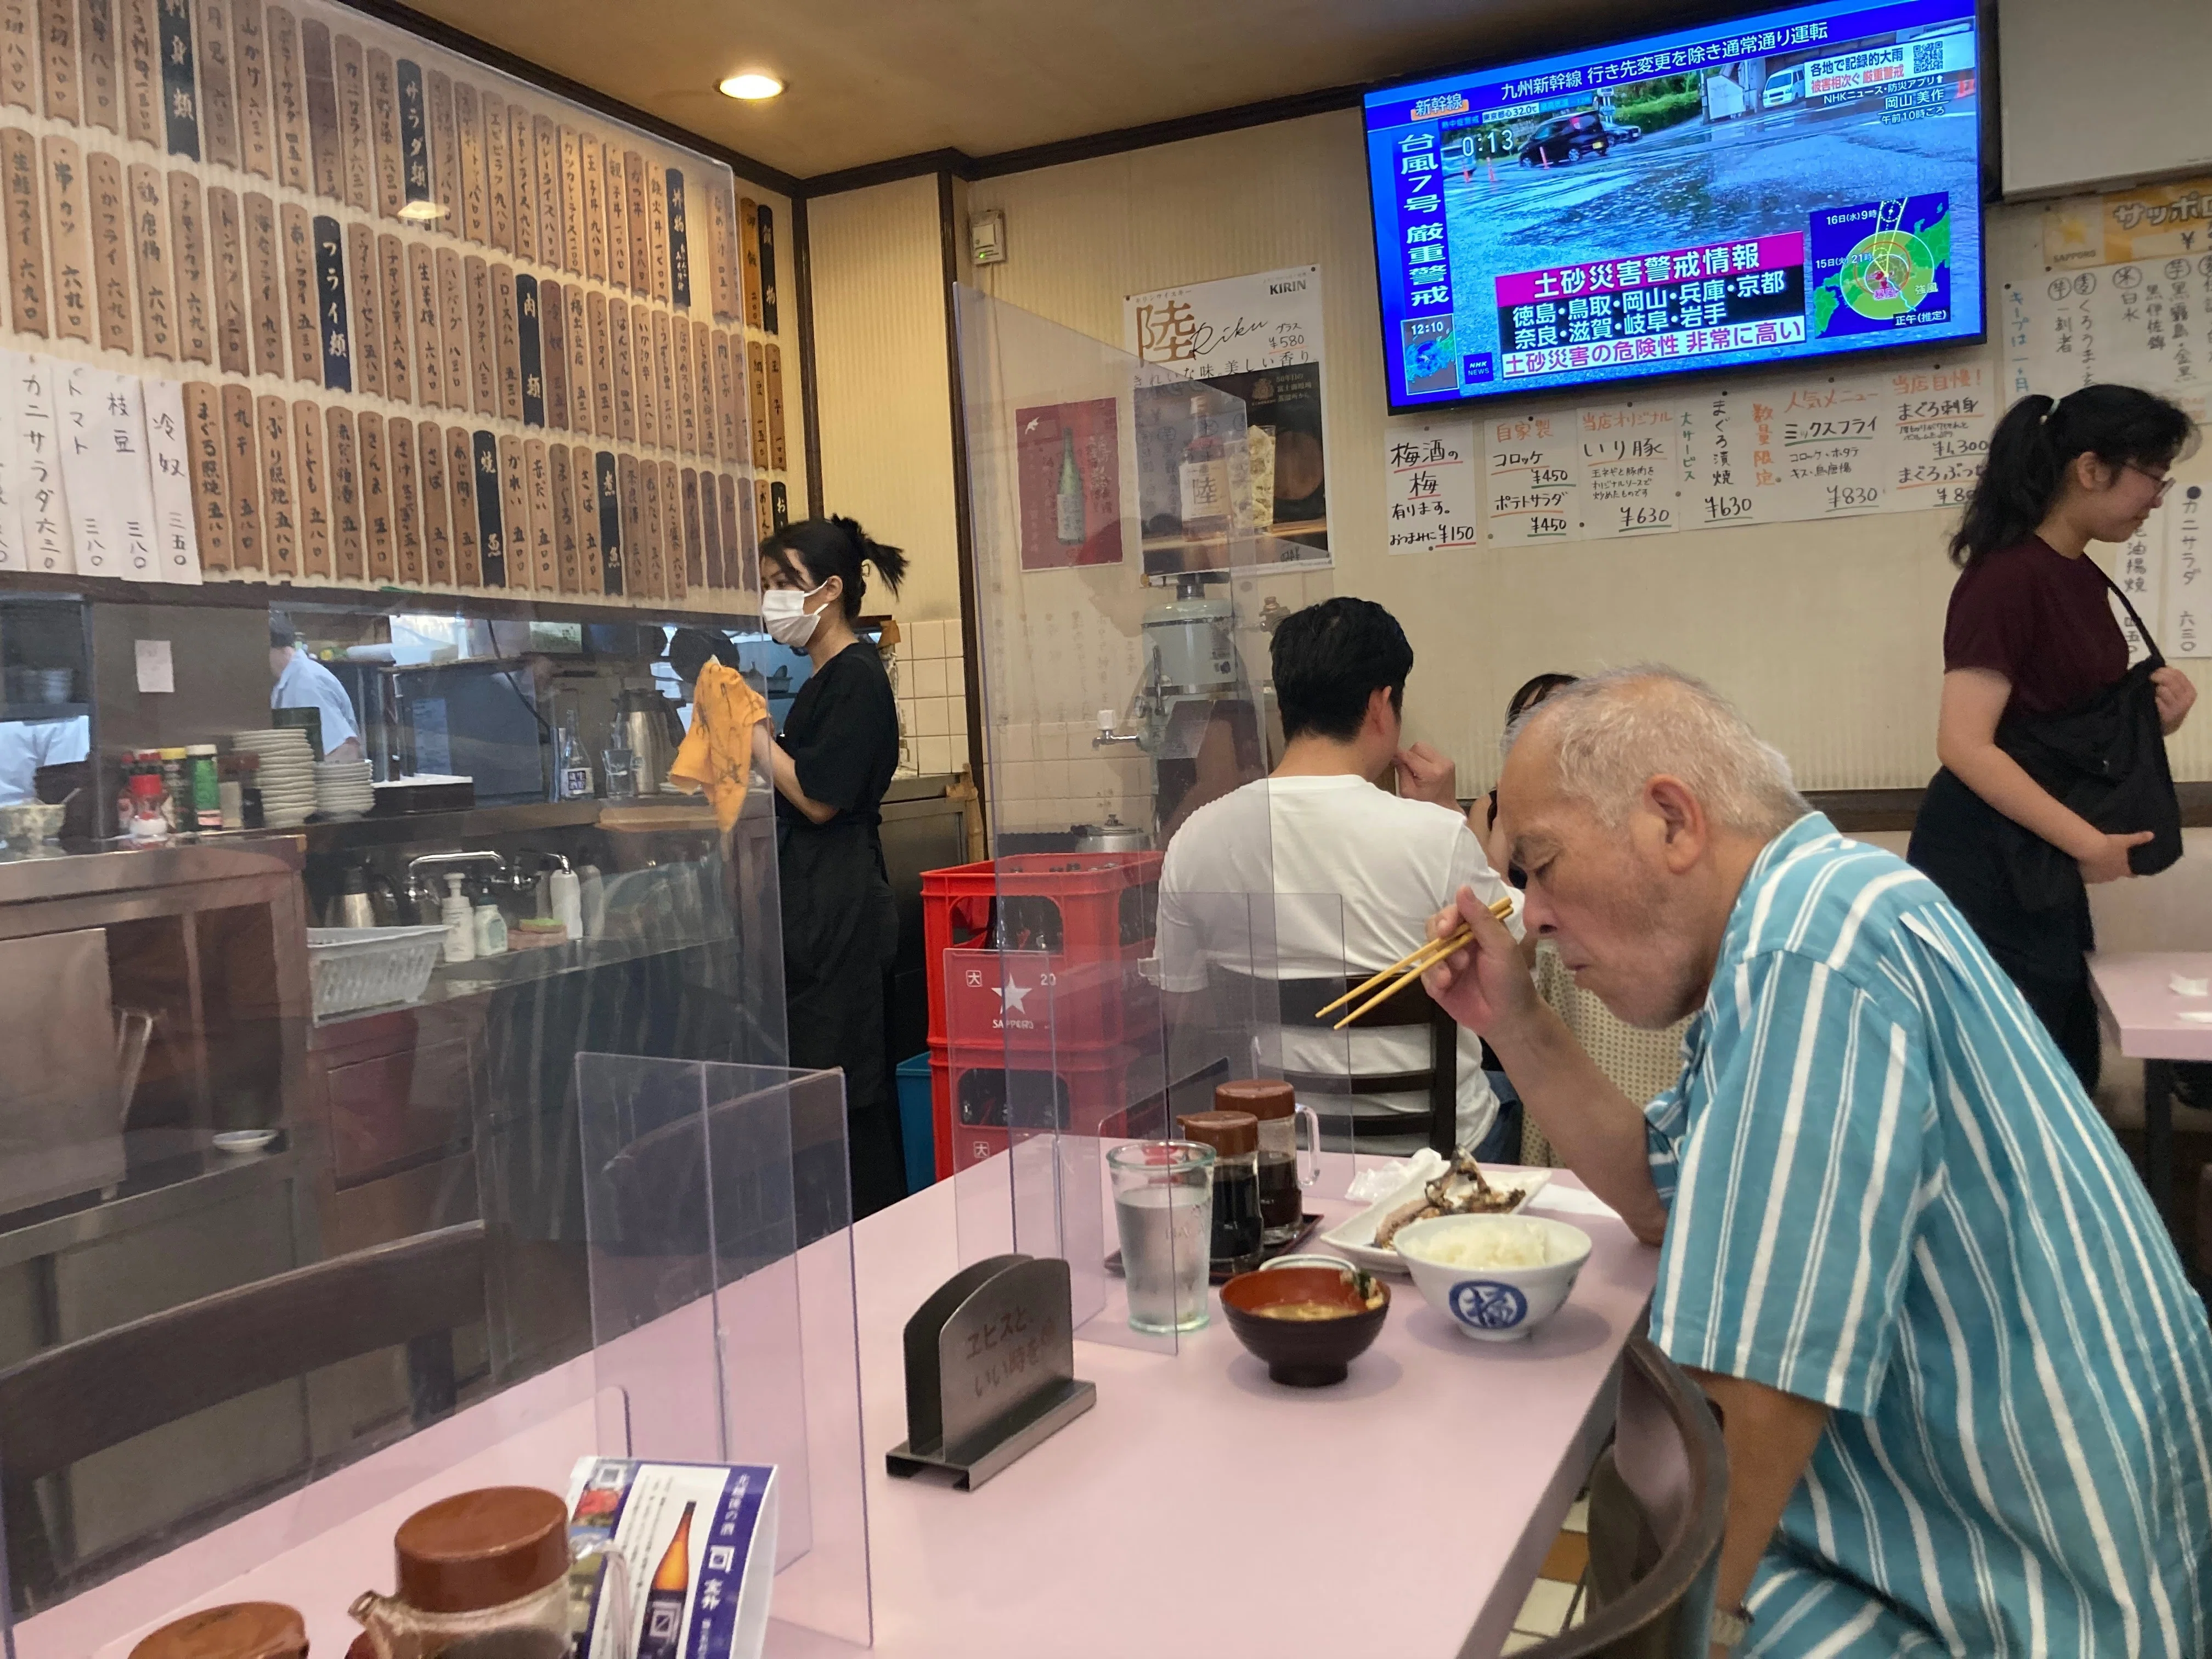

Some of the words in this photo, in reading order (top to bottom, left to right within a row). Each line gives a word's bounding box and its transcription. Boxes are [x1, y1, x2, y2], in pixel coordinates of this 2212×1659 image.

[1501, 70, 1582, 101] 九州新幹線
[1588, 21, 1828, 85] 行き先変更を除き通常通り運転
[1810, 47, 1903, 77] 各地で記録的大雨
[1811, 71, 1860, 93] 被害相次ぐ
[1863, 64, 1904, 84] 厳重警戒
[1824, 76, 1935, 104] NHKニュース・防災アプリ
[1415, 93, 1463, 117] 新幹線
[1884, 94, 1912, 110] 岡山
[1917, 88, 1944, 103] 美作
[1882, 105, 1945, 125] 午前10時ごろ
[403, 78, 426, 187] サラダ類
[1463, 129, 1514, 157] 0:13
[1398, 133, 1442, 213] 台風7号
[1406, 222, 1450, 307] 厳重警戒
[1533, 242, 1760, 299] 土砂災害警戒情報
[322, 241, 346, 356] フライ類
[1269, 279, 1307, 296] KIRIN
[1513, 270, 1786, 328] 徳島・鳥取・岡山・兵庫・京都
[1874, 289, 1898, 301] 暴風
[1915, 282, 1939, 295] 強風
[1276, 321, 1303, 331] グラス
[1411, 320, 1444, 336] 12:10
[1515, 302, 1728, 352] 奈良・滋賀・岐阜・岩手
[1895, 309, 1947, 326] 正午(推定)
[1136, 300, 1197, 369] 陸
[1190, 317, 1269, 361] Riku
[1269, 334, 1305, 349] ¥580
[1505, 335, 1679, 376] 土砂災害の危険性
[1686, 320, 1802, 352] 非常に高い
[1468, 367, 1489, 377] NEWS
[1469, 360, 1487, 370] NHK
[1784, 388, 1878, 413] 人気メニュー
[1898, 396, 1979, 421] まぐろ刺身
[1496, 420, 1553, 443] 自家製
[1583, 411, 1674, 431] 当店オリジナル
[1785, 416, 1877, 439] ミックスフライ
[153, 413, 185, 476] 冷奴
[1391, 439, 1459, 468] 梅酒の
[1584, 437, 1664, 460] いり豚
[1680, 412, 1696, 482] 大サービス
[1753, 403, 1776, 488] 数量限定
[1932, 439, 1989, 456] ¥1,300
[303, 422, 318, 493] ししゃも
[1494, 450, 1544, 467] コロッケ
[67, 379, 88, 457] トマト
[84, 517, 106, 566] 三八〇
[106, 391, 136, 454] 枝豆
[127, 520, 149, 569] 三八〇
[507, 453, 524, 505] かれい
[532, 459, 548, 510] 赤だい
[1409, 470, 1439, 496] 梅
[1531, 469, 1568, 484] ¥450
[1592, 478, 1652, 490] オリジナルソースで
[1495, 490, 1569, 512] ポテトサラダ
[1593, 488, 1649, 501] 炒めたものです
[1826, 485, 1878, 509] ¥830
[1391, 500, 1451, 521] 有ります。
[1620, 506, 1670, 527] ¥630
[1705, 496, 1752, 518] ¥630
[1390, 529, 1437, 547] おつまみに
[1438, 524, 1475, 544] ¥150
[1531, 516, 1567, 532] ¥450
[168, 511, 189, 565] 三五〇
[2181, 500, 2202, 585] カニサラダ
[2179, 611, 2198, 652] 六三〇
[967, 971, 981, 986] 大
[1041, 973, 1057, 986] 20
[992, 1019, 1034, 1030] SAPPORO
[974, 1143, 989, 1157] 大
